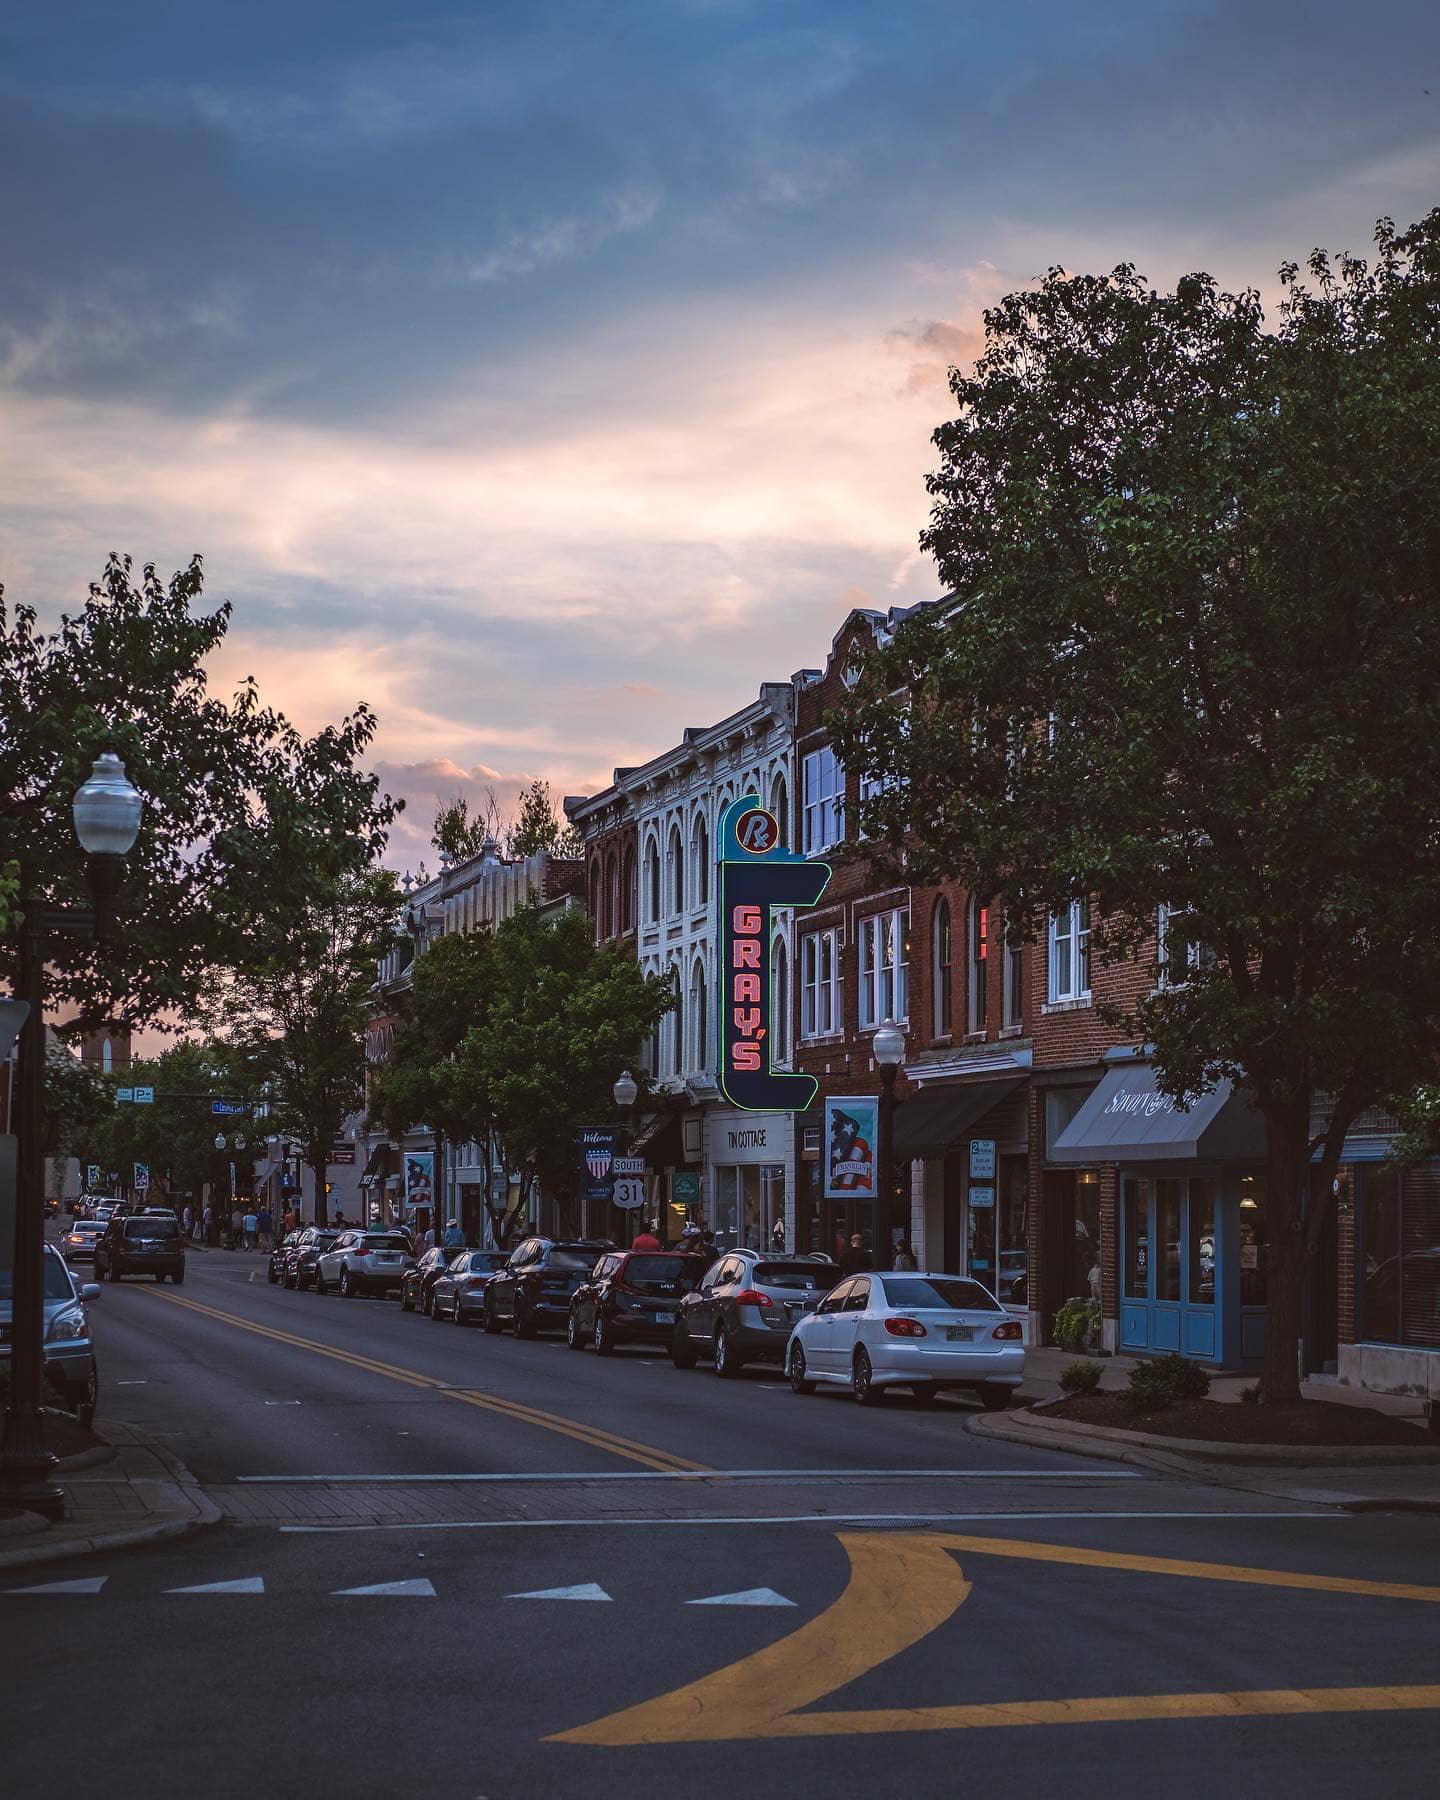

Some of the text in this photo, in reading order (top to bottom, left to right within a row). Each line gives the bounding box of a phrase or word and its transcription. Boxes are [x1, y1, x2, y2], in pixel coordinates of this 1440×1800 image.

[743, 815, 769, 847] Rx
[732, 905, 767, 1072] GRAY'S
[137, 1090, 145, 1100] P
[583, 1132, 615, 1143] Welcome
[728, 1130, 767, 1148] TIN COTTAGE
[614, 1160, 643, 1171] SOUTH
[619, 1184, 637, 1201] 31
